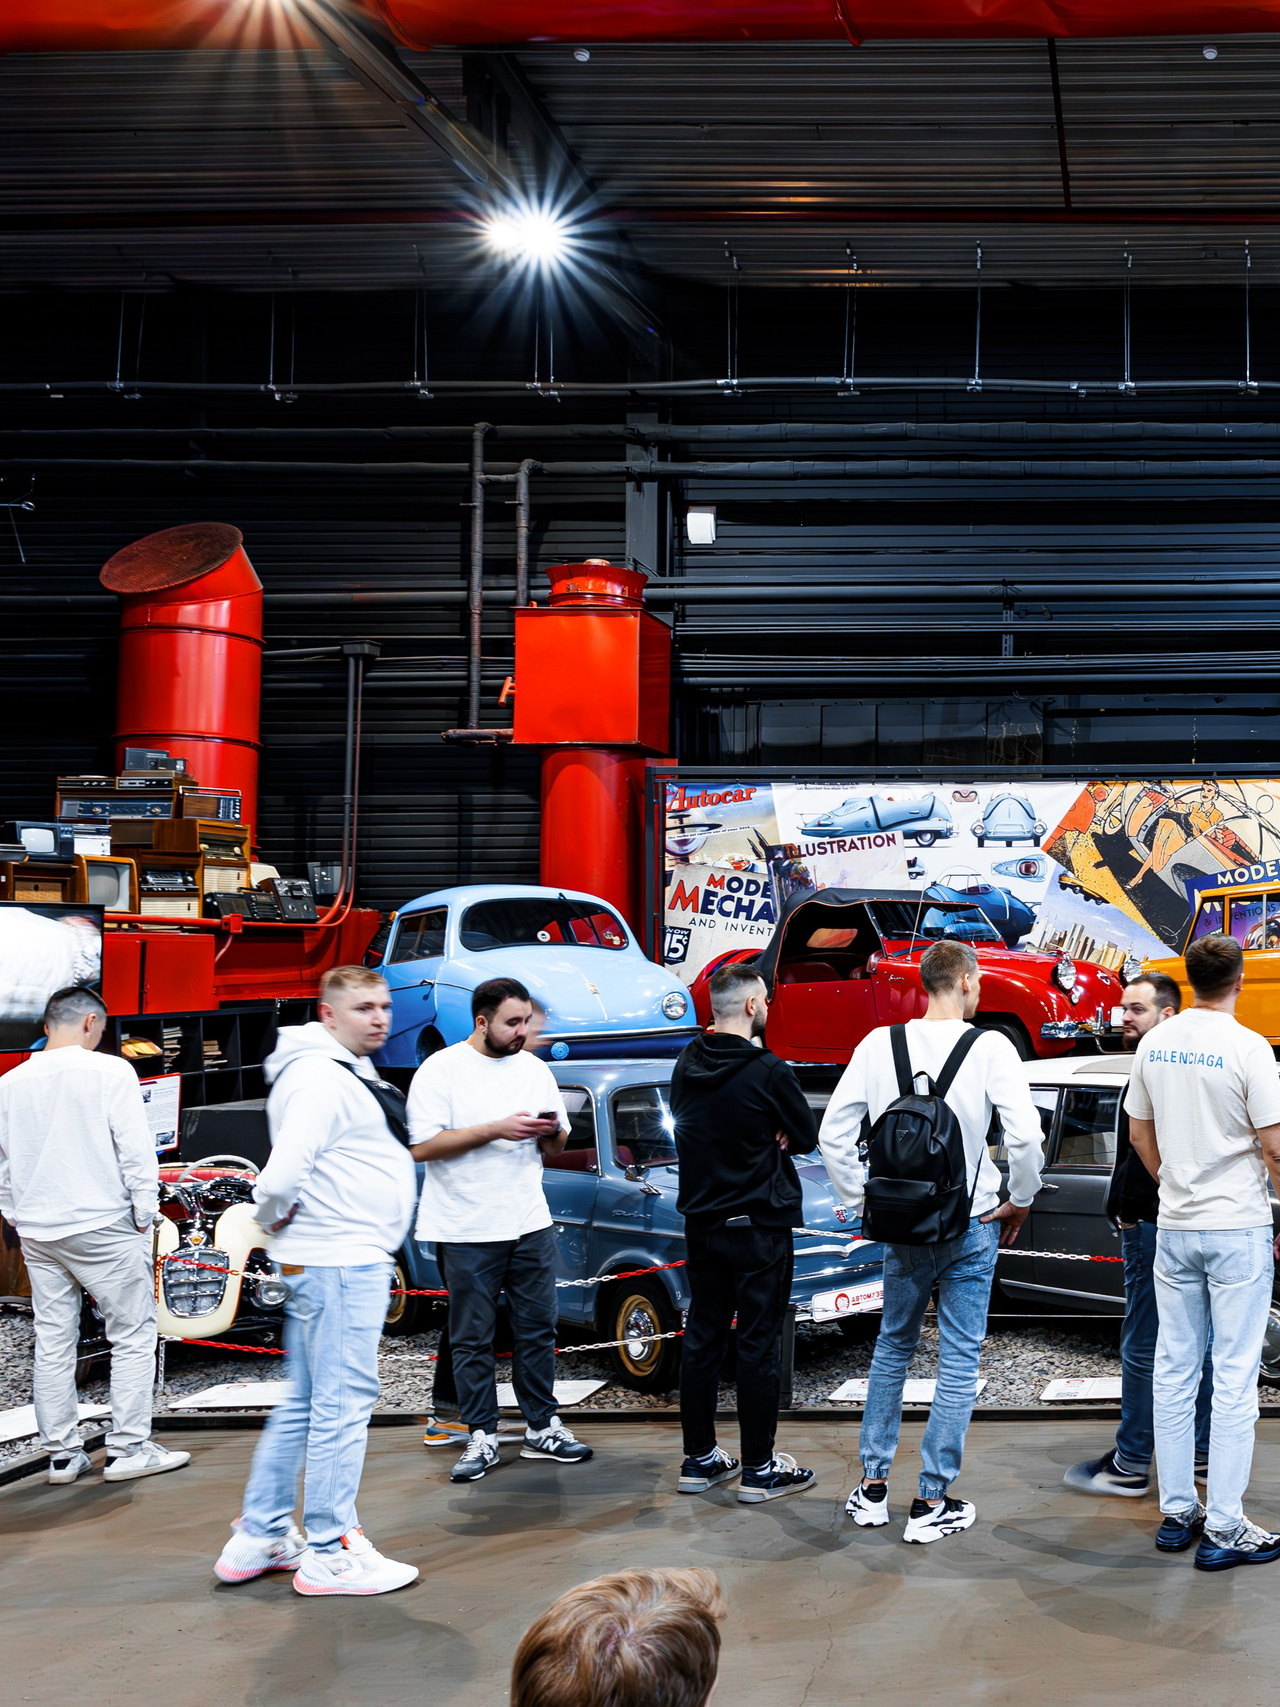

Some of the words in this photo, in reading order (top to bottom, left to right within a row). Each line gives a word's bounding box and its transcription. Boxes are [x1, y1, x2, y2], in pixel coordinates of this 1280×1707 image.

[665, 786, 757, 812] Autocar
[668, 879, 775, 924] MECHA
[665, 926, 690, 934] NOW
[688, 917, 716, 928] AND
[724, 922, 774, 937] INVENT
[1149, 1049, 1223, 1069] BALENCIAGA
